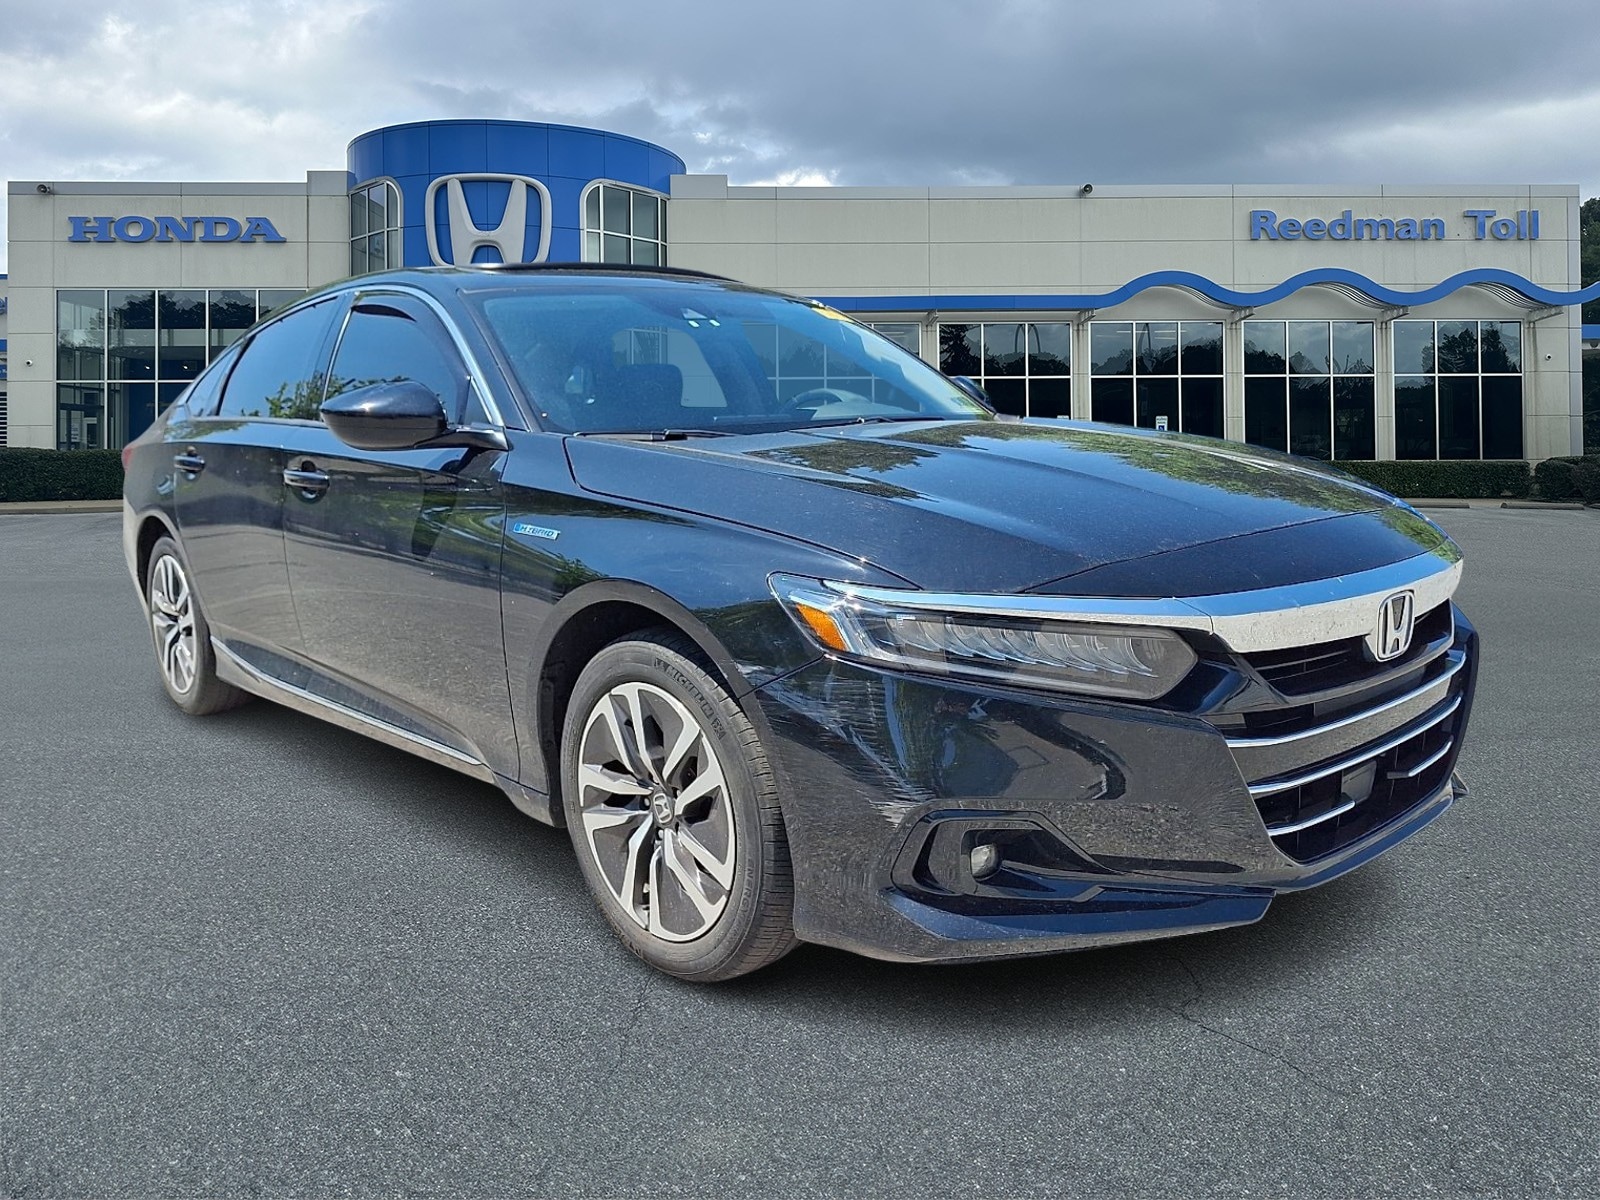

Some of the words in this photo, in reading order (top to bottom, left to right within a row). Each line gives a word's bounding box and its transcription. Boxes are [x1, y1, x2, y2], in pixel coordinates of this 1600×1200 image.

[68, 215, 287, 242] HONDA
[1250, 209, 1445, 240] Reedman
[1464, 209, 1540, 240] Toll
[520, 524, 555, 537] HYBRID
